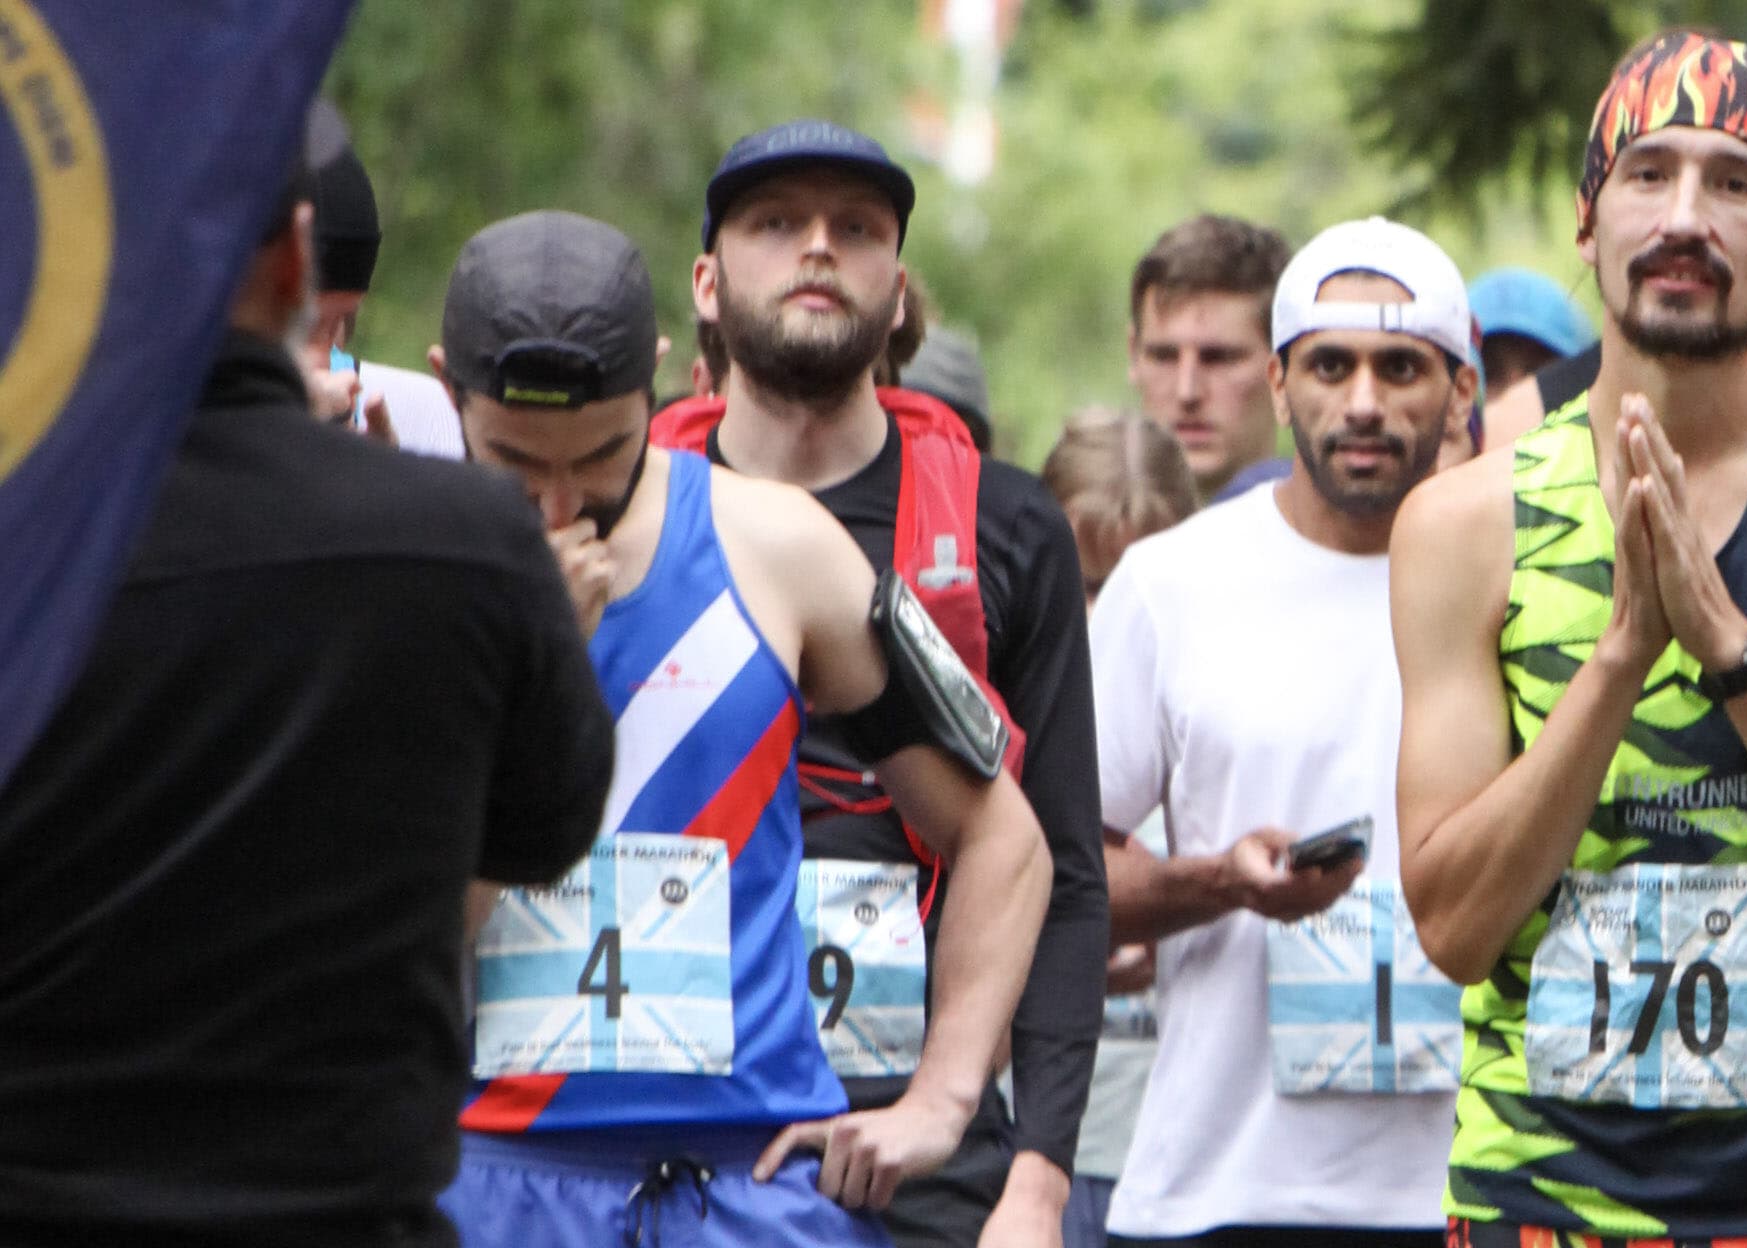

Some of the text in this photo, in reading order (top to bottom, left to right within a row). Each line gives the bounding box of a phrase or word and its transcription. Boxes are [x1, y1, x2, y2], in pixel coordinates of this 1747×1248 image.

[577, 928, 629, 1019] 4
[807, 944, 855, 1030] 9
[1375, 960, 1393, 1046] 1
[1588, 959, 1730, 1056] 170
